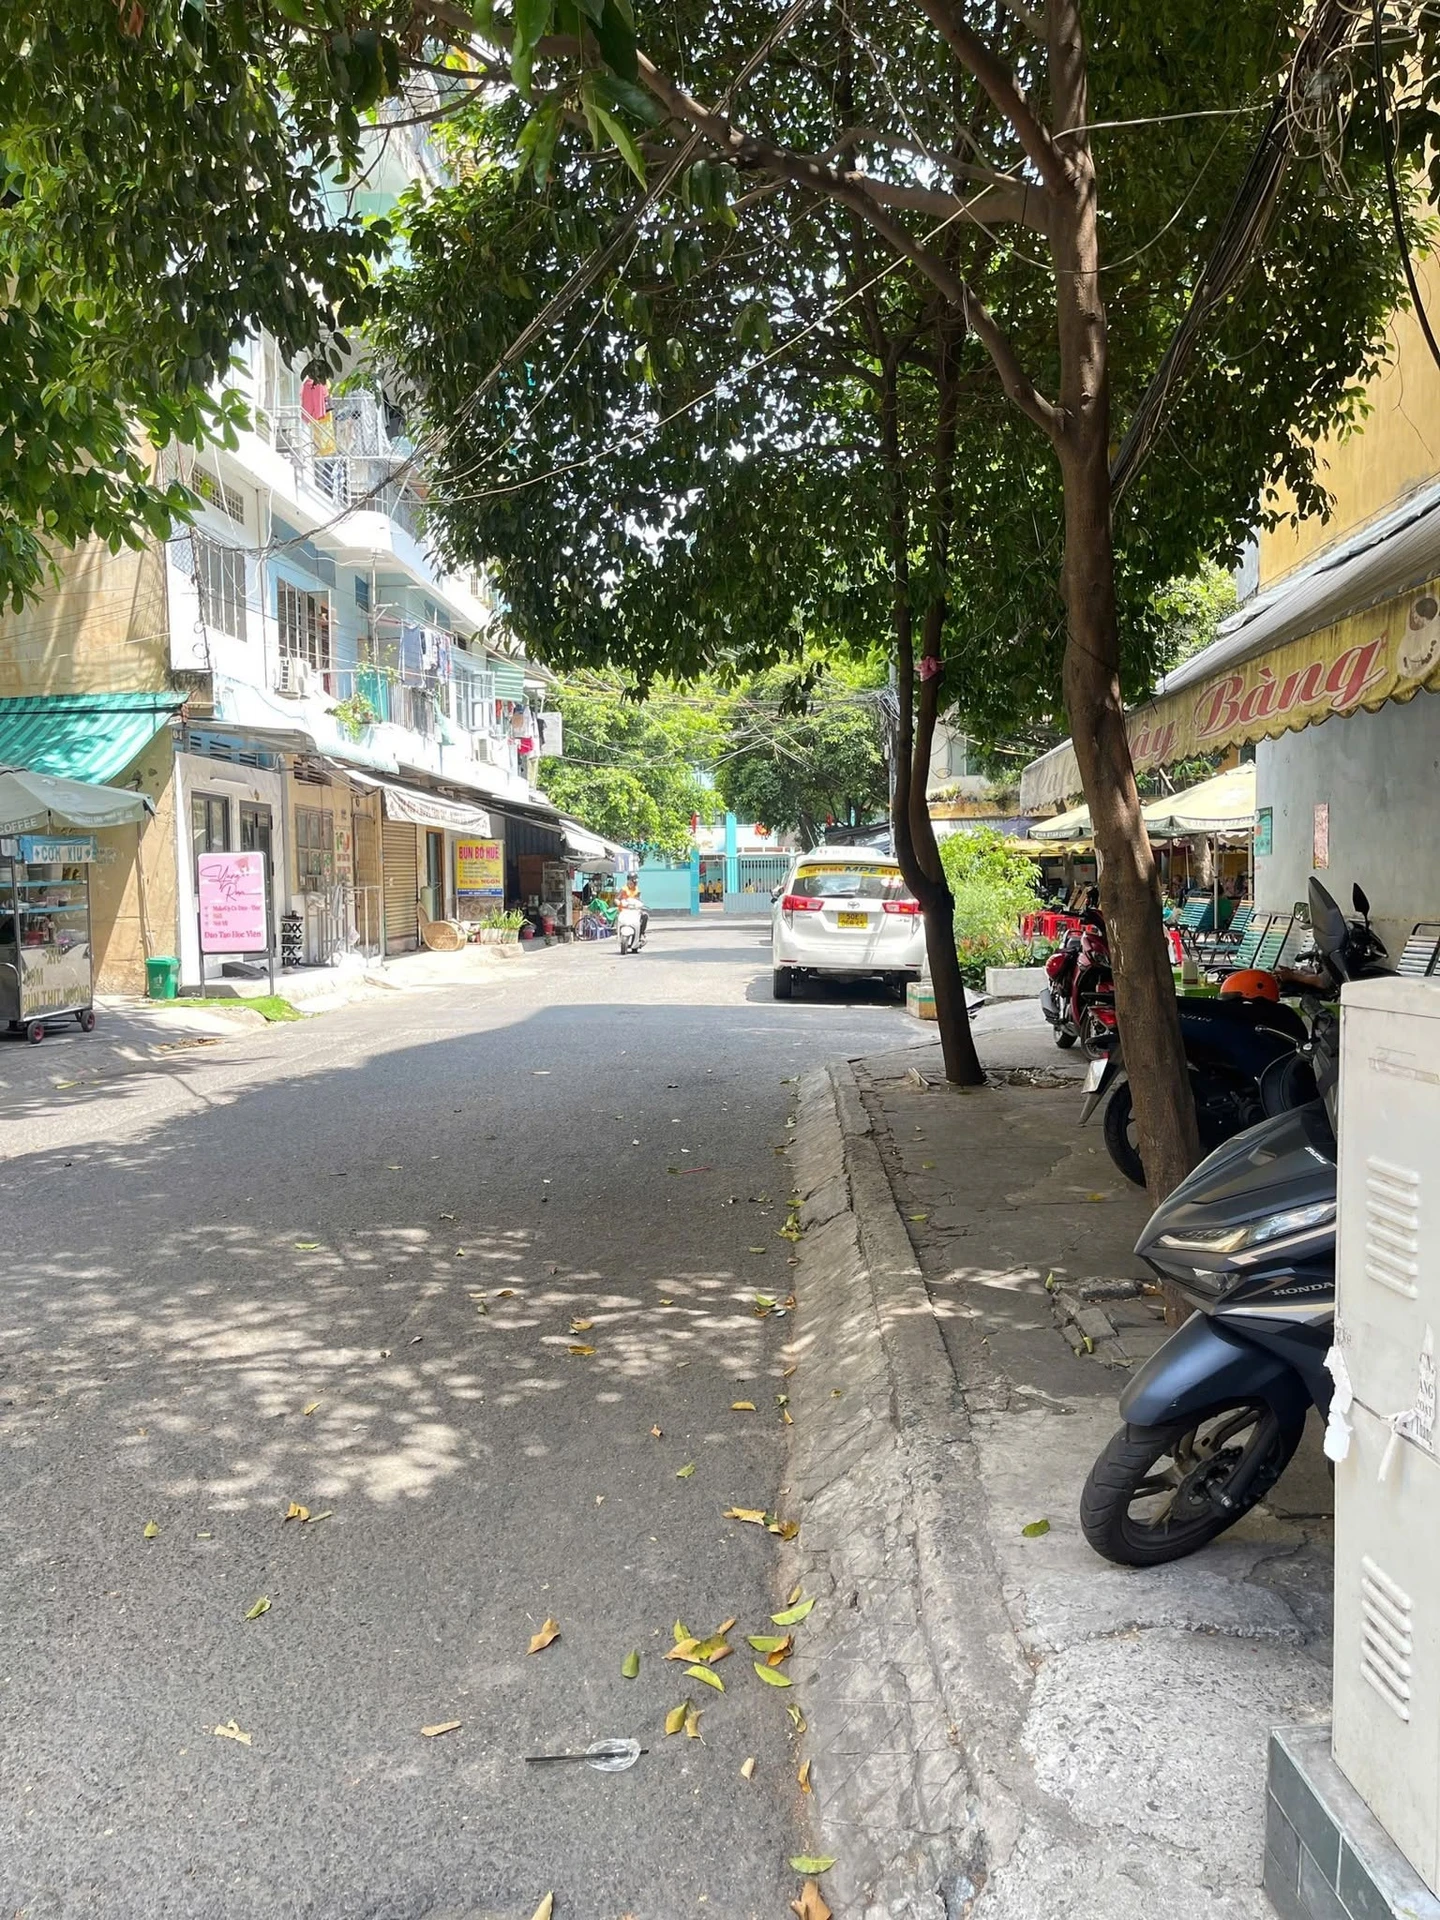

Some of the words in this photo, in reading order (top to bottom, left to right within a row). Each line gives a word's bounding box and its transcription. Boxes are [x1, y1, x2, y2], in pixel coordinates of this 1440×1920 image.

[1126, 720, 1178, 764] ây
[1194, 629, 1388, 737] Bàng
[845, 866, 880, 874] MPE
[1272, 1281, 1335, 1296] HONDA
